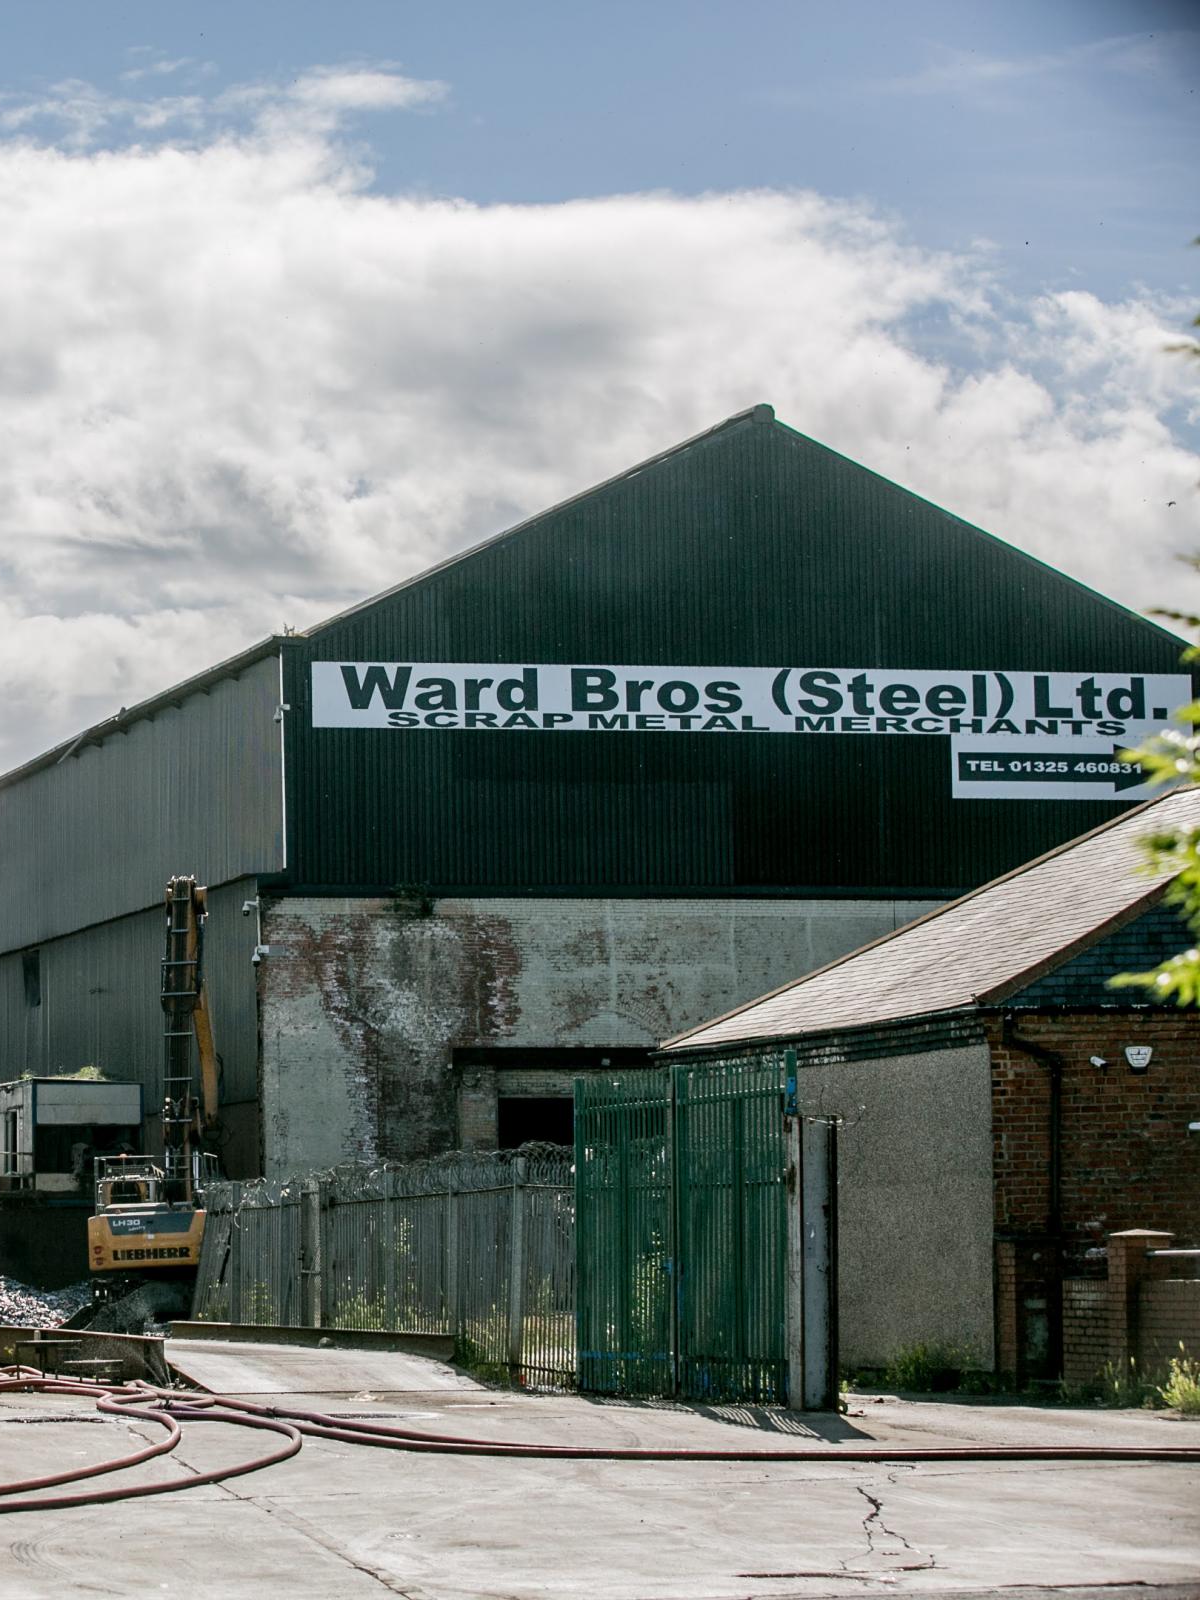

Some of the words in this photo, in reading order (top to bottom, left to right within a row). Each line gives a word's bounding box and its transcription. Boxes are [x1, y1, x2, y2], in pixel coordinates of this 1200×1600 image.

[340, 665, 539, 711] Ward
[570, 667, 743, 713] Bros
[771, 668, 1015, 719] (Steel)
[1033, 674, 1168, 720] Ltd.
[387, 711, 574, 729] SCRAP
[588, 713, 770, 731] METAL
[794, 715, 1128, 736] MERCHANTS
[966, 760, 1005, 772] TEL
[1009, 761, 1069, 773] 01325
[1073, 762, 1142, 774] 460831
[112, 1247, 190, 1261] LIEBHERR
